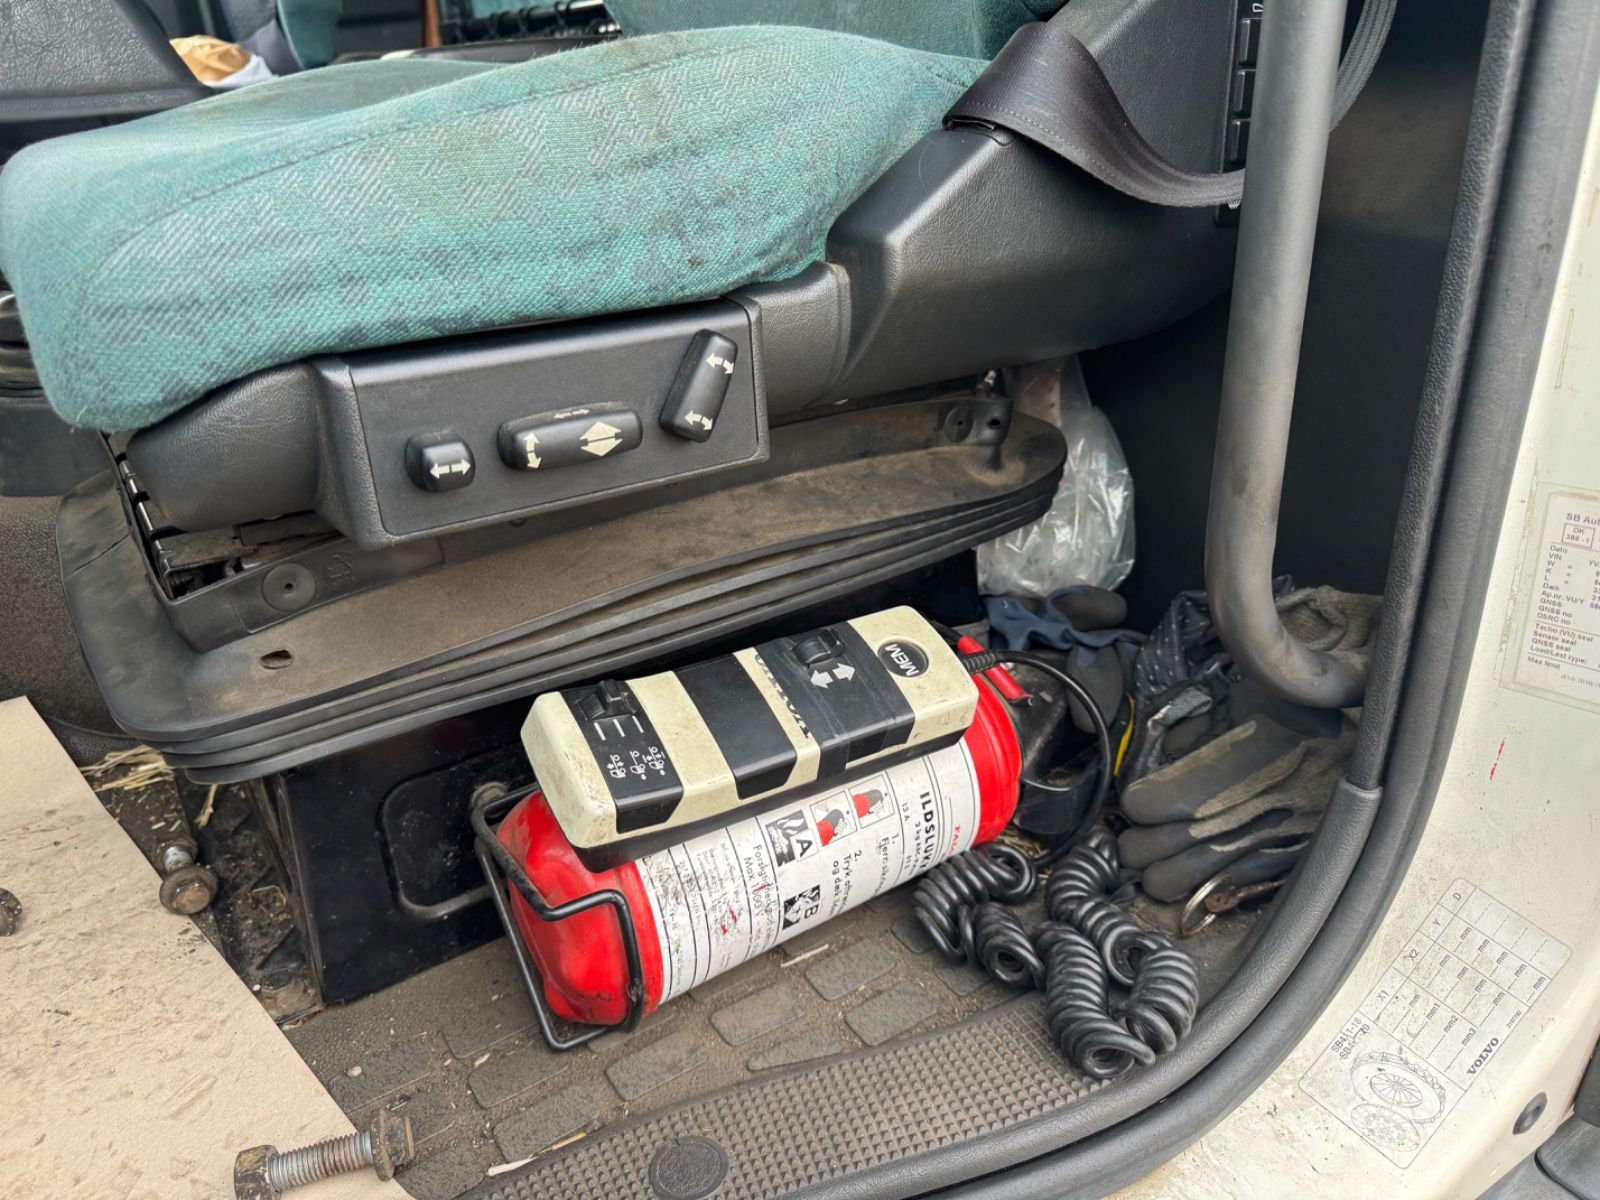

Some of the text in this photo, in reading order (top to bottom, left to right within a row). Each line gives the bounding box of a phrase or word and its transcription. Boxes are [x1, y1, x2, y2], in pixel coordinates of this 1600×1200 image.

[1566, 512, 1581, 521] SB
[1573, 527, 1584, 535] DK
[1550, 545, 1568, 554] Dato
[1549, 552, 1600, 568] VIN YV
[885, 643, 919, 676] MEM
[795, 839, 813, 857] A
[854, 849, 862, 861] 2.
[744, 857, 755, 880] Max
[832, 861, 839, 875] og
[843, 854, 853, 877] Tryk
[1452, 892, 1462, 901] D
[804, 905, 819, 919] B
[1460, 927, 1472, 940] mm
[1478, 939, 1490, 952] mm
[1407, 948, 1419, 960] X2
[1440, 954, 1451, 967] mm
[1496, 951, 1508, 965] mm
[1457, 966, 1469, 980] mm
[1515, 964, 1527, 978] mm
[1475, 979, 1487, 993] mm
[1534, 976, 1546, 990] mm
[1376, 989, 1389, 1001] X1
[1408, 994, 1420, 1007] mm
[1493, 992, 1505, 1006] mm
[1443, 1014, 1459, 1033] mm2
[1461, 1028, 1477, 1046] mm3
[1466, 1037, 1499, 1075] VOLVO
